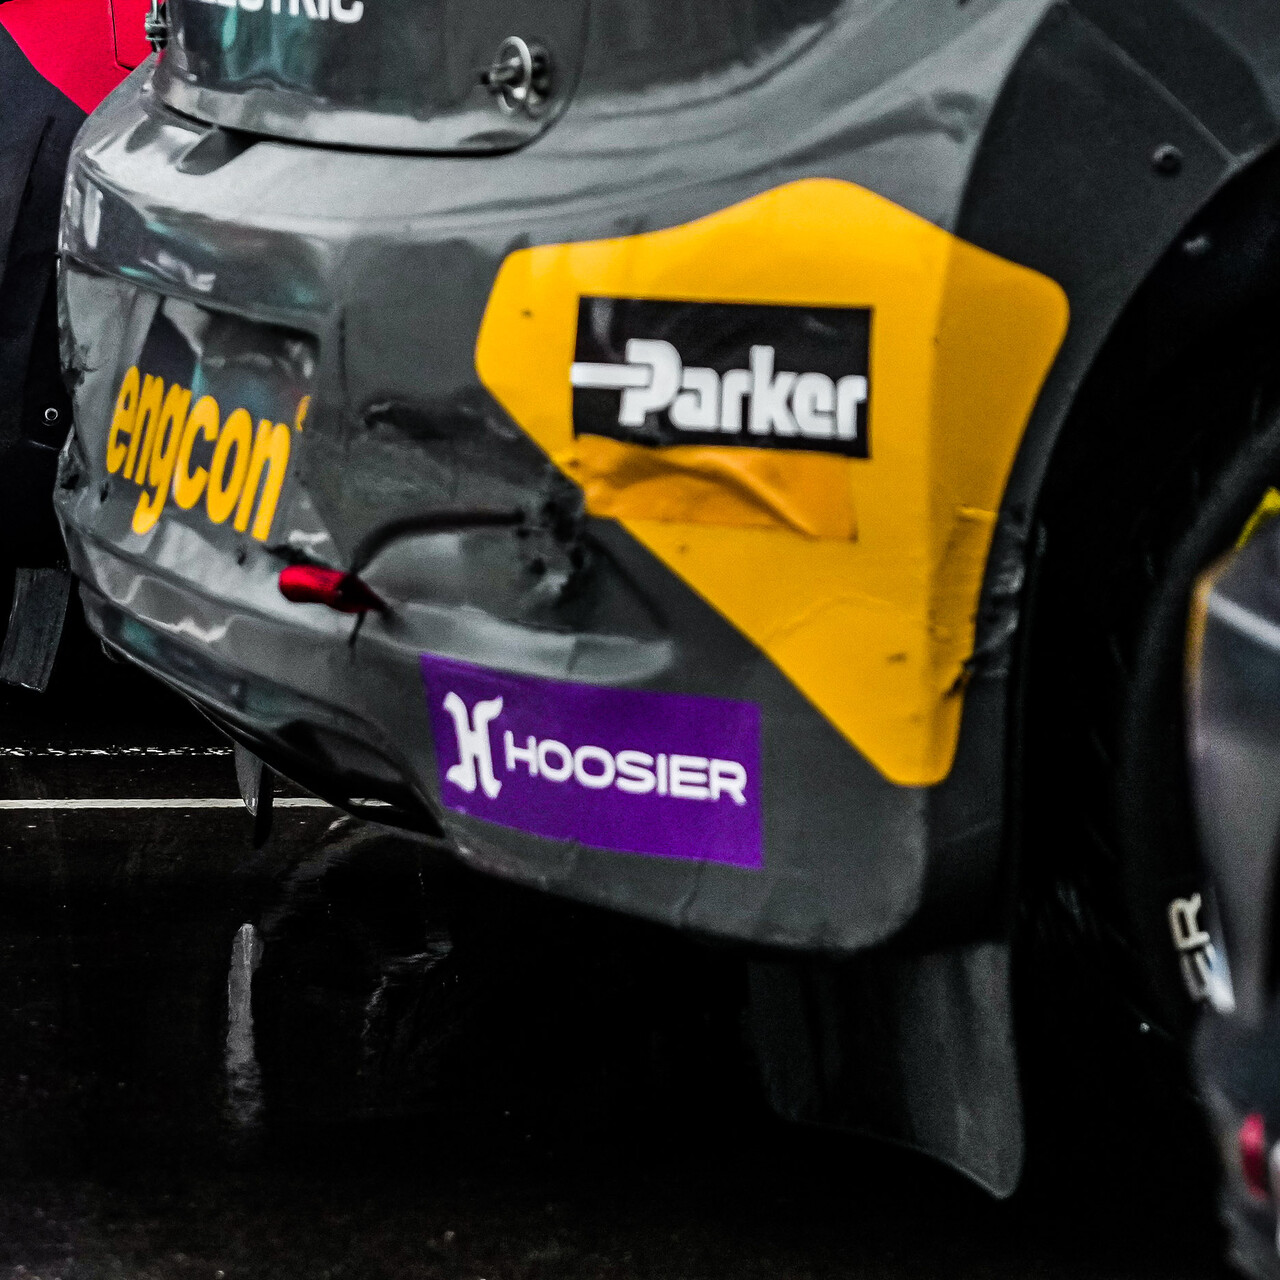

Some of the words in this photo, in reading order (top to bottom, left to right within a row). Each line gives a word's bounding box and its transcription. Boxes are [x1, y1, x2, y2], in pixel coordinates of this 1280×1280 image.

[617, 338, 867, 440] Parker
[106, 365, 291, 542] engcon
[503, 729, 749, 806] HOOSIER
